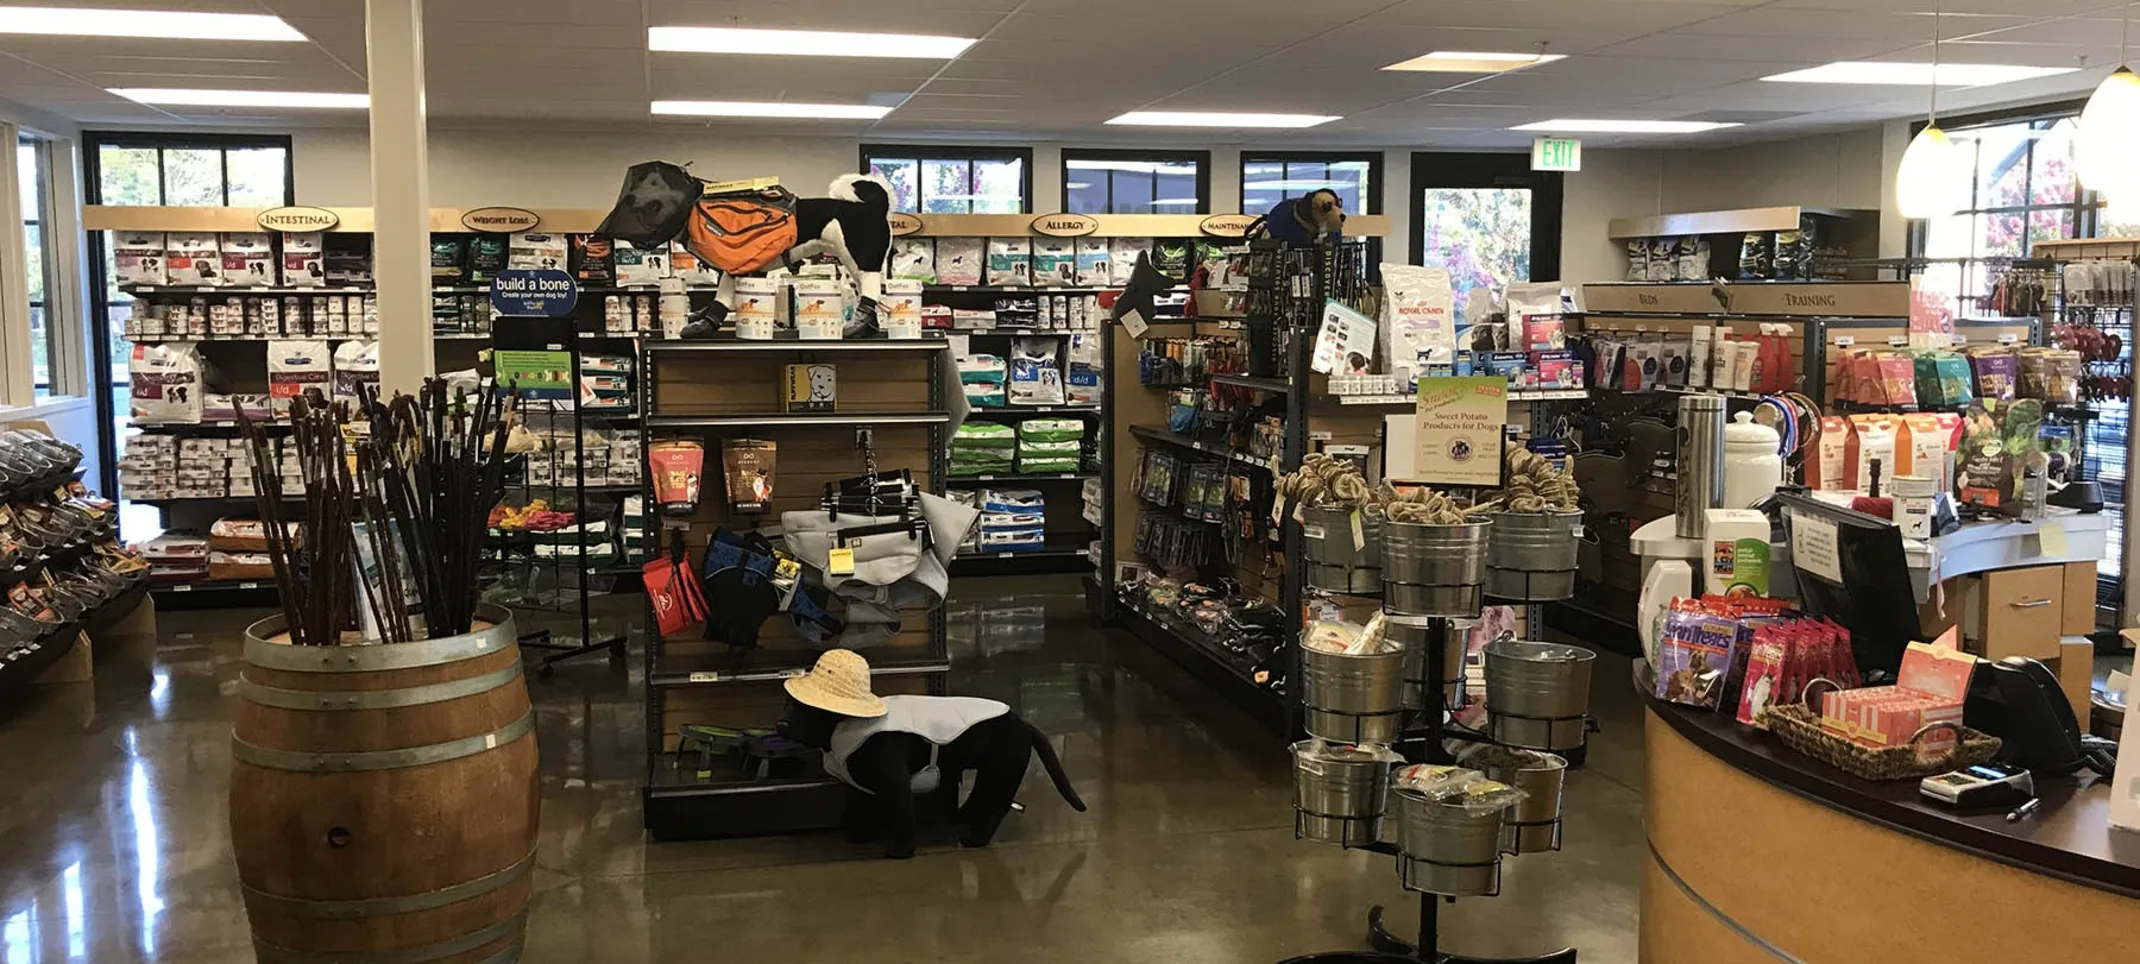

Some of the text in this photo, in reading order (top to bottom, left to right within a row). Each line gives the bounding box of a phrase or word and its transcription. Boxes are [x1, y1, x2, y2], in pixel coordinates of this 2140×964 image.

[1543, 141, 1575, 167] EXIT
[265, 215, 330, 225] INTESTINAL
[472, 216, 529, 224] WEIGHT LOSS
[1045, 221, 1086, 230] ALLERGY
[496, 277, 570, 291] build a bone
[1639, 293, 1659, 304] BEDS
[1784, 293, 1836, 306] TRAINING
[1398, 307, 1421, 315] ROYAL
[1073, 376, 1089, 384] d/d
[1460, 412, 1488, 420] Potato
[1423, 421, 1499, 432] Products for Dogs
